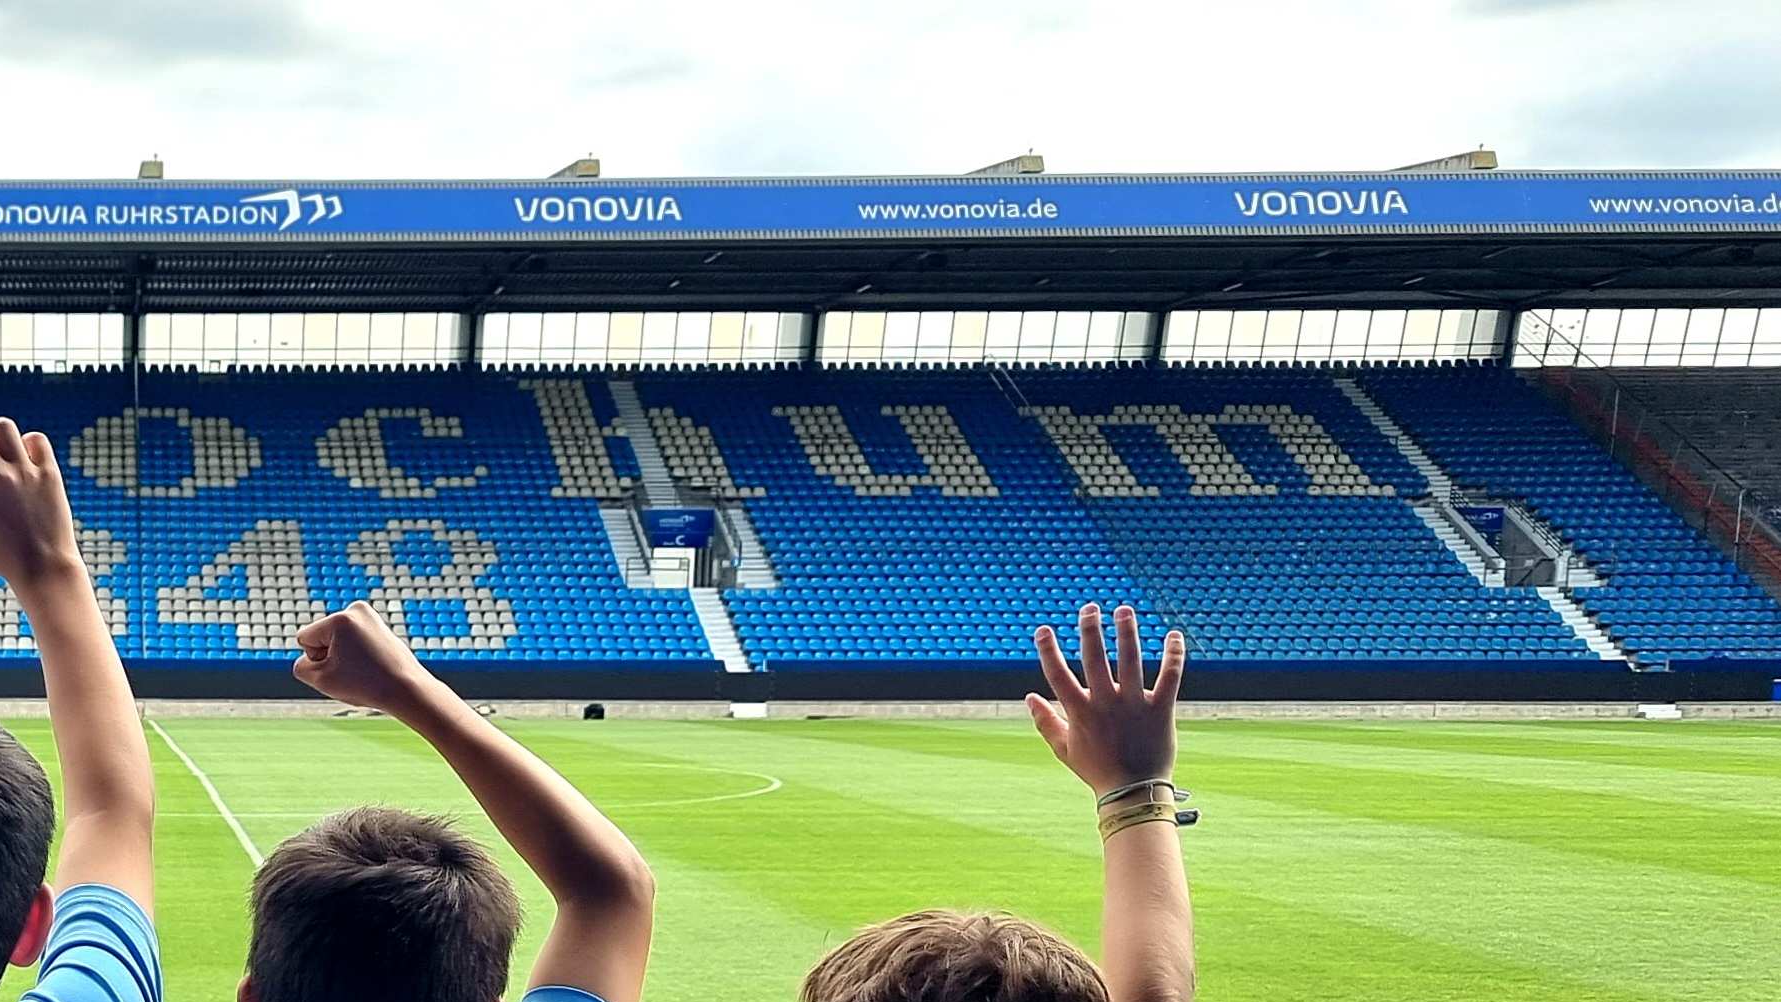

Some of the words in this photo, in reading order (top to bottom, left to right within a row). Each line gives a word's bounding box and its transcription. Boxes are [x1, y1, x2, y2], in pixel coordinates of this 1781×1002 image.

[858, 197, 1059, 219] www.vonovia.de
[1588, 192, 1781, 214] www.vonovia.d
[95, 205, 278, 225] RUHRSTADION
